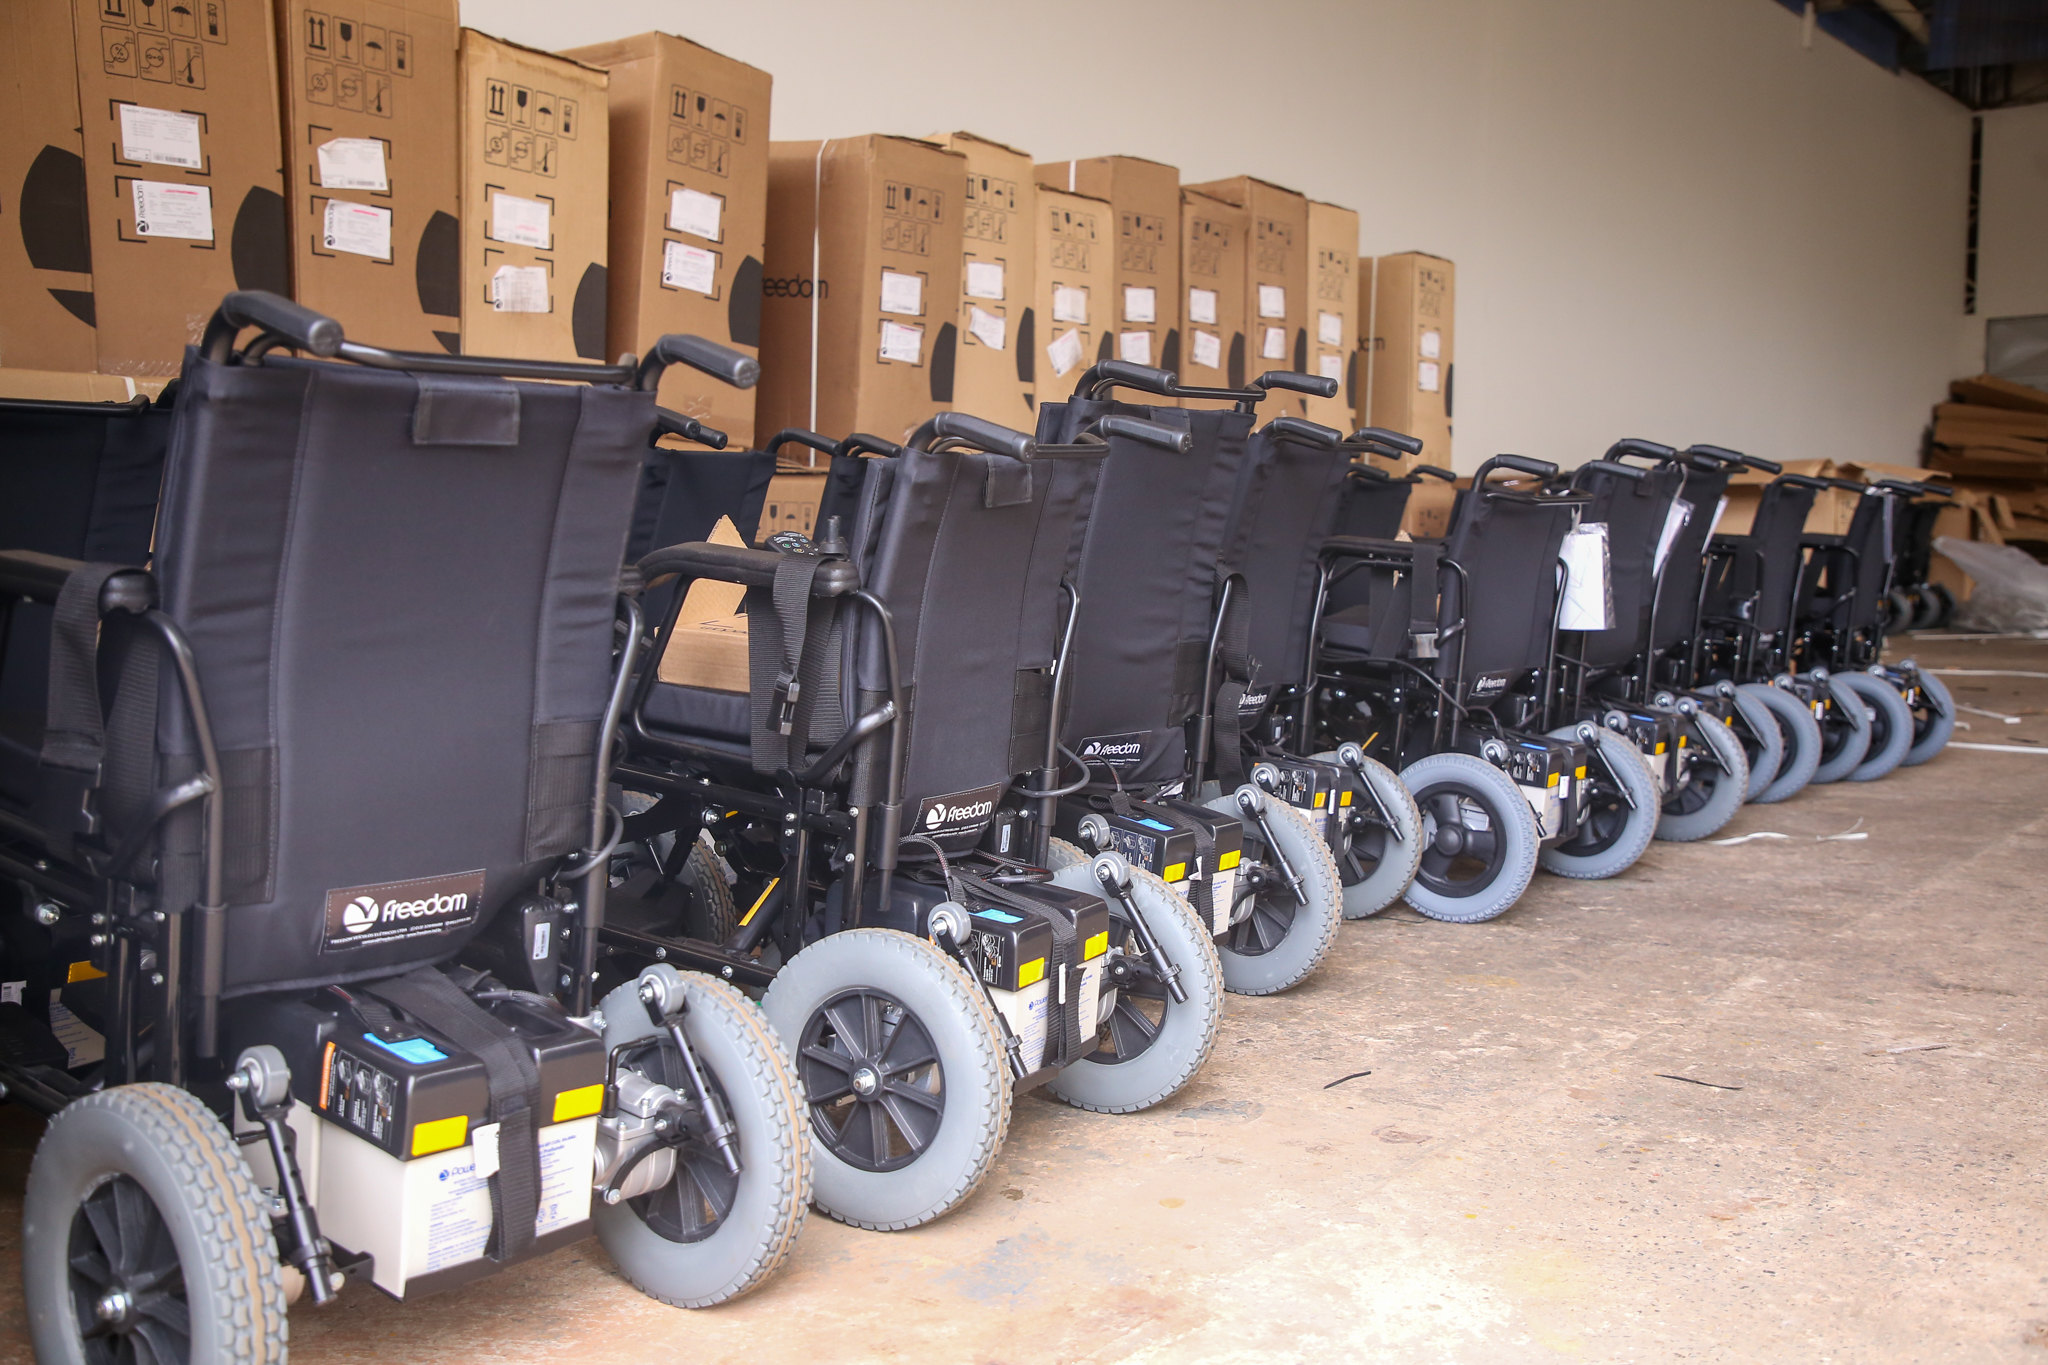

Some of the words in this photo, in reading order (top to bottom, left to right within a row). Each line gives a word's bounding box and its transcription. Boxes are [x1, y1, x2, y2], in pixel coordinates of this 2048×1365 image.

[762, 273, 829, 299] eedom
[1100, 742, 1141, 756] freedom
[946, 801, 992, 823] freedom
[381, 893, 468, 923] freedom
